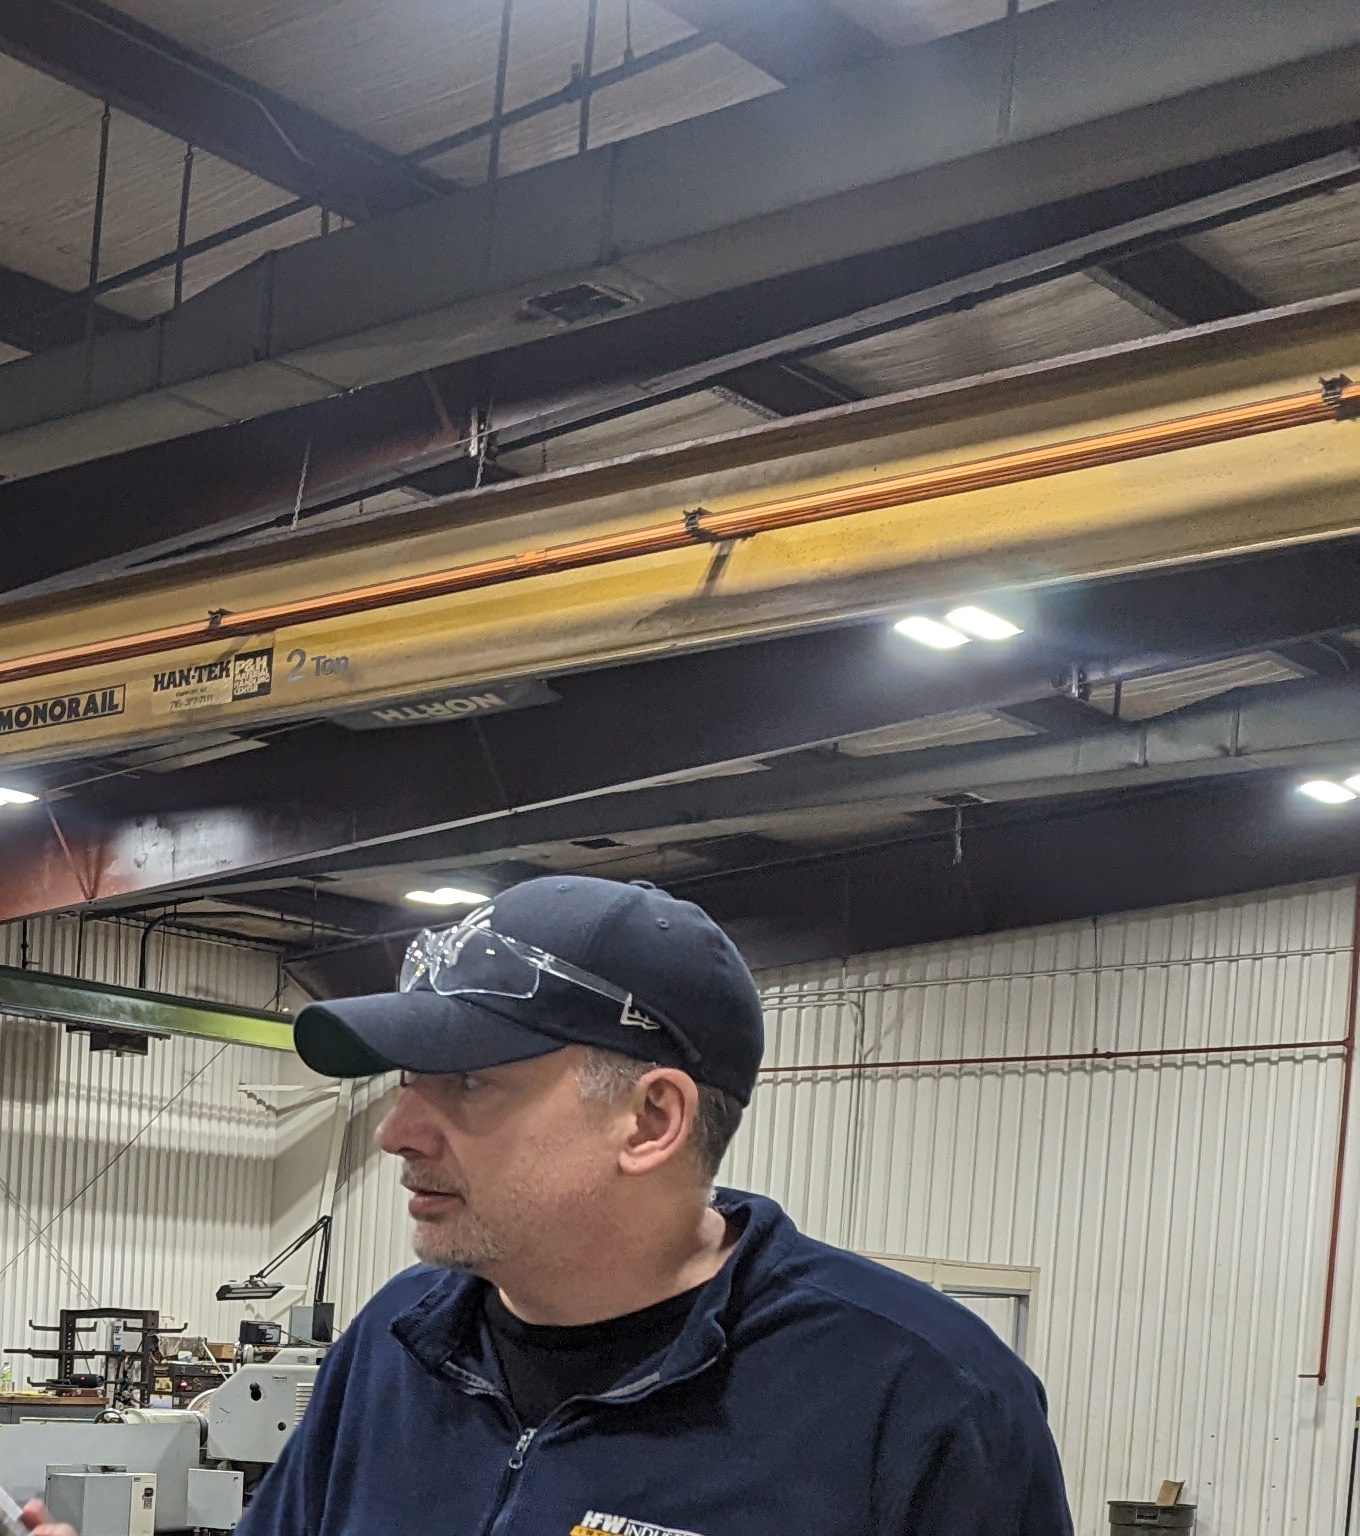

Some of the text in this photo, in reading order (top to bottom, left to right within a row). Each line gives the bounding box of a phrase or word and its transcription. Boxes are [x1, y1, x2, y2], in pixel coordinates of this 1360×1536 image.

[234, 655, 268, 675] P&H
[287, 648, 349, 682] 2 Ton
[373, 693, 507, 723] NORTH
[581, 1510, 627, 1536] HFW
